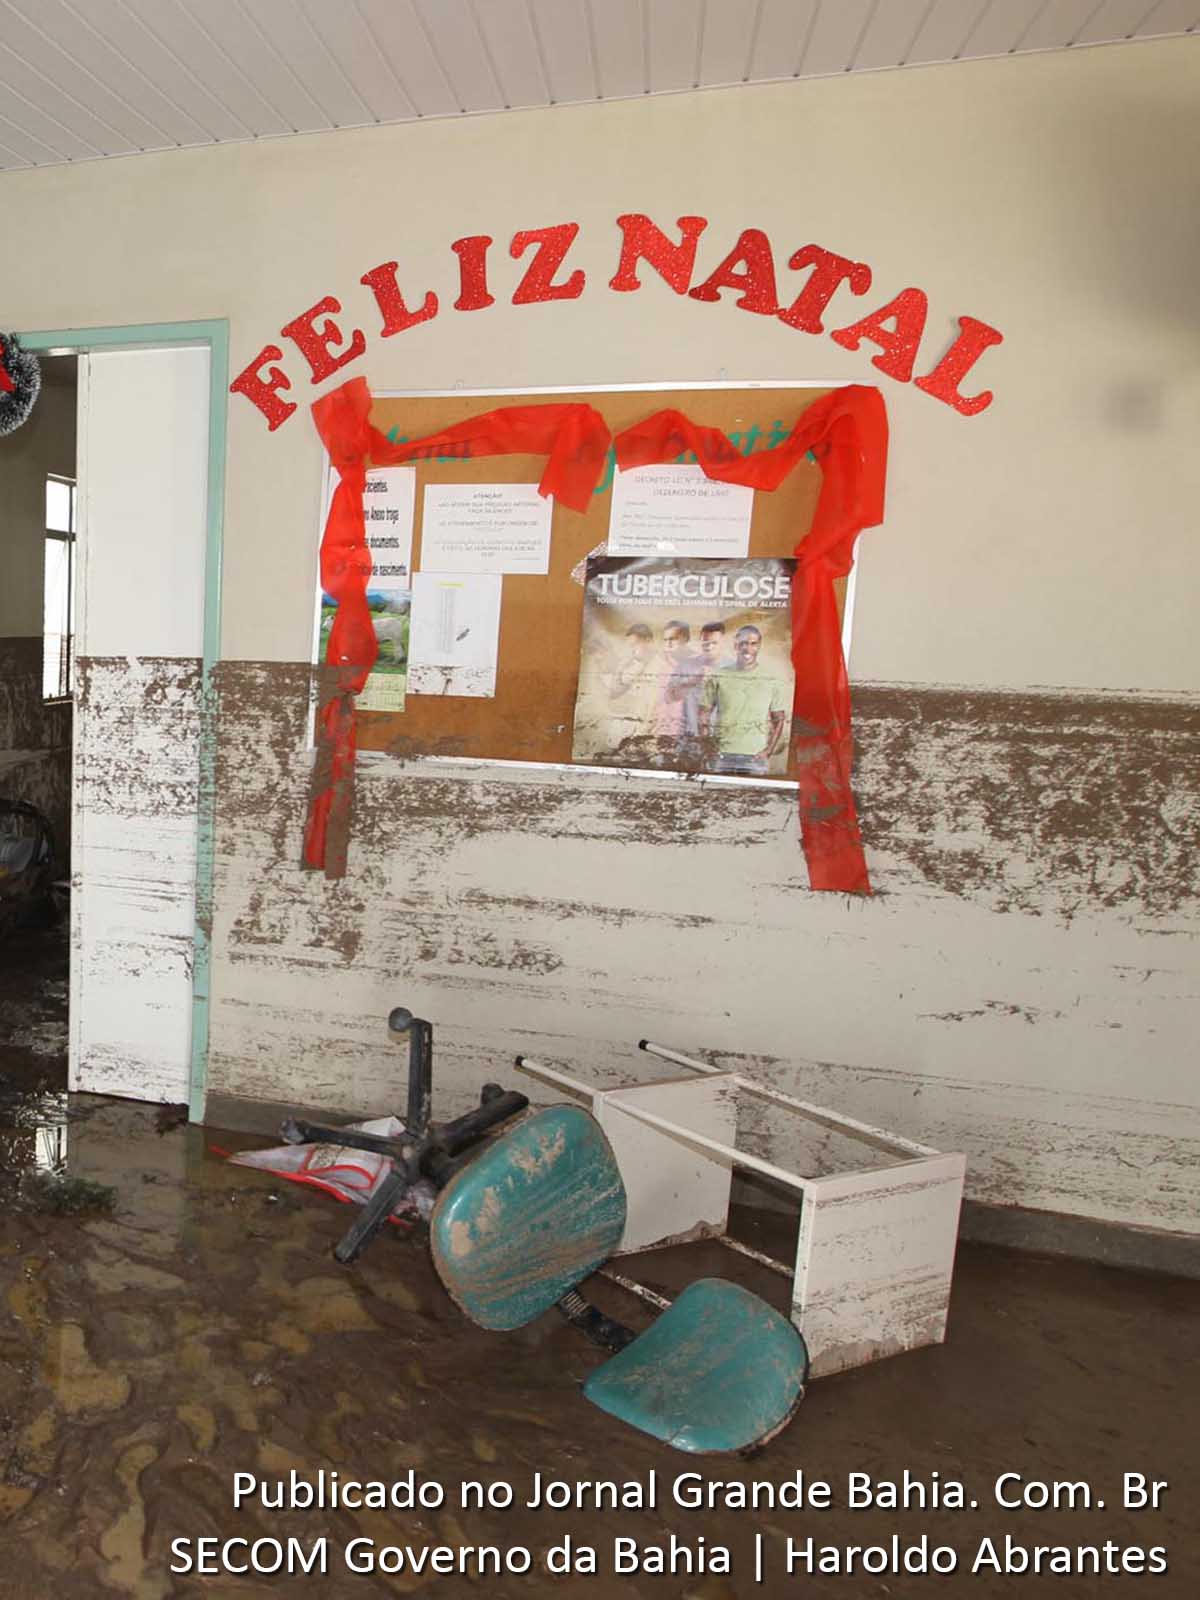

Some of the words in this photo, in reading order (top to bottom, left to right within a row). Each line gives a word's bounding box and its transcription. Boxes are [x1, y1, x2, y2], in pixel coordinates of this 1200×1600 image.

[230, 222, 585, 431] FELIZ
[609, 213, 1002, 416] NATAL
[597, 573, 792, 599] TUBERCULOSE
